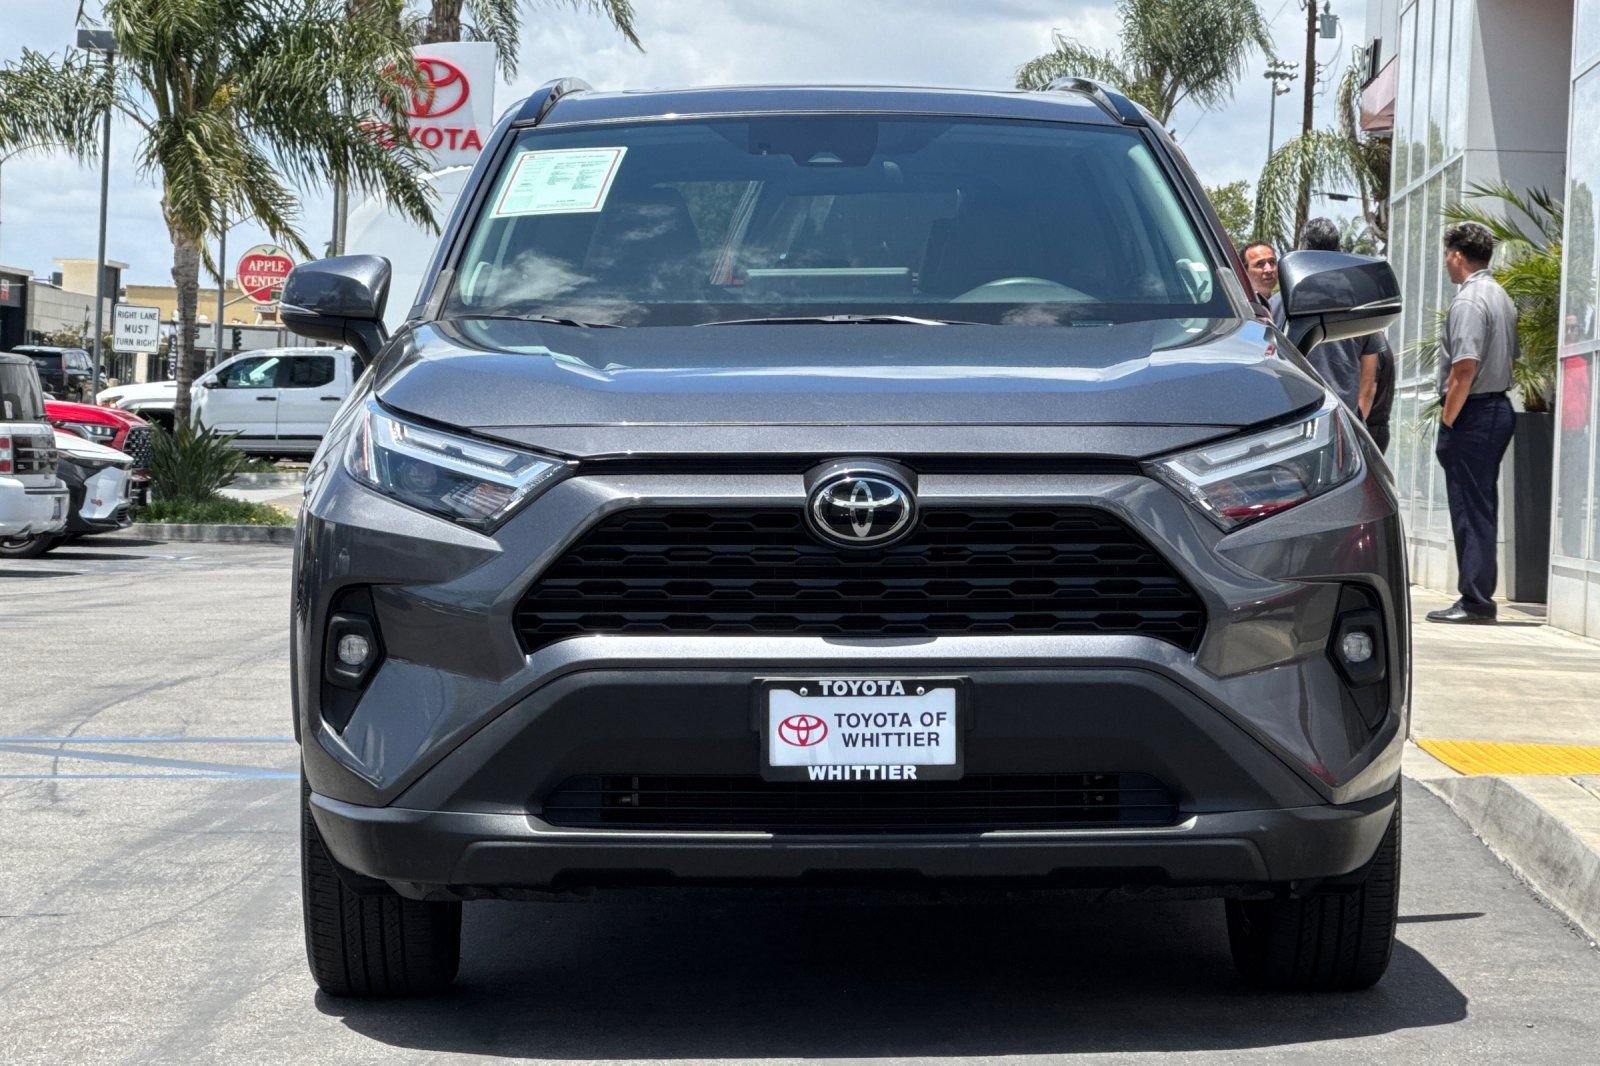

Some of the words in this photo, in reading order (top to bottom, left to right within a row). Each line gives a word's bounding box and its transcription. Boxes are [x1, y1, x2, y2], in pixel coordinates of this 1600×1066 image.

[358, 122, 483, 152] OTA
[248, 260, 286, 272] APPLE
[117, 311, 137, 319] RIGHT
[140, 312, 158, 320] LANE
[124, 324, 149, 335] MUST
[116, 337, 134, 346] TURN
[136, 339, 157, 347] RIGHT
[819, 680, 906, 696] TOYOTA
[834, 712, 912, 729] TOYOTA
[919, 711, 948, 727] OF
[842, 731, 940, 748] WHITTIER
[808, 765, 918, 781] WHITTIER
